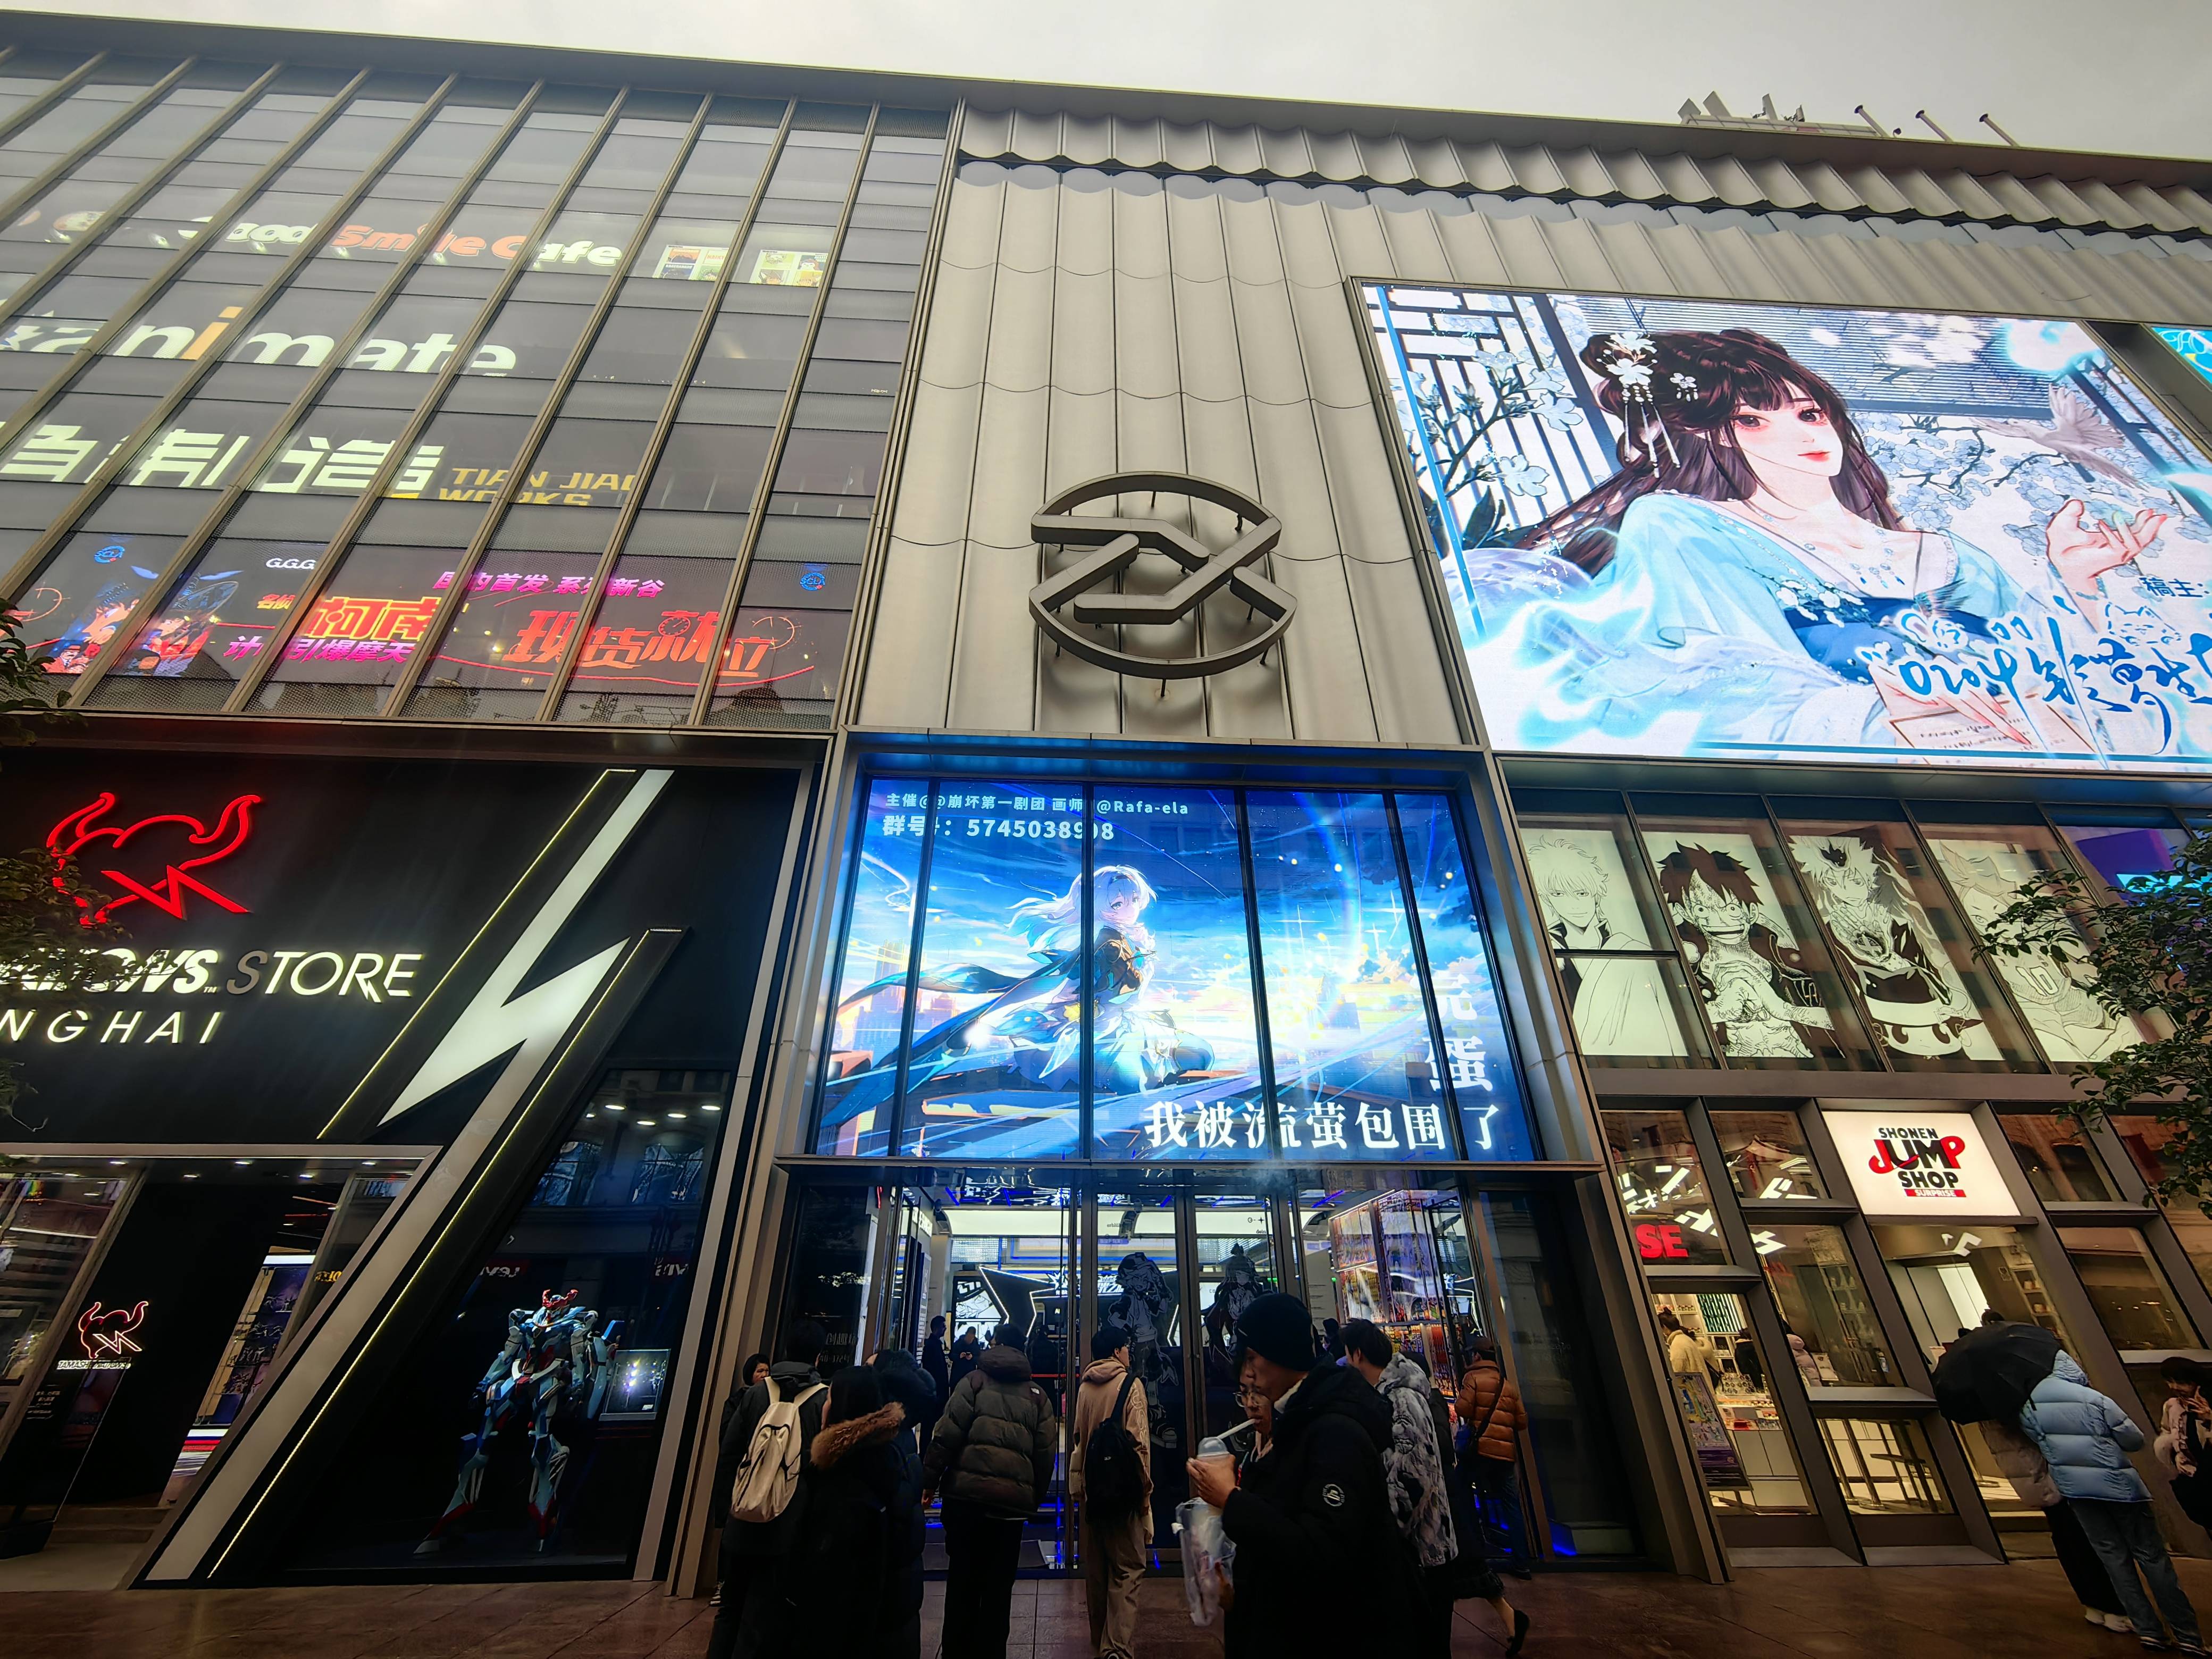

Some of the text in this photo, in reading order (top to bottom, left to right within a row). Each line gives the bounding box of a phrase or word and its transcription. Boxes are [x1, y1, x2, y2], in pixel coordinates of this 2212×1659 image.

[330, 222, 487, 256] Smle
[266, 558, 317, 570] GGG
[223, 635, 416, 664] 计引爆摩天
[1096, 800, 1188, 815] @Rafa-ela
[227, 950, 423, 1004] STORE
[2015, 965, 2060, 997] 10
[0, 1008, 225, 1044] NGHAI
[1878, 1127, 1939, 1139] SHONEN
[1869, 1135, 1966, 1174] JUMP
[1897, 1170, 1959, 1188] SHOP
[1634, 1223, 1690, 1259] SE
